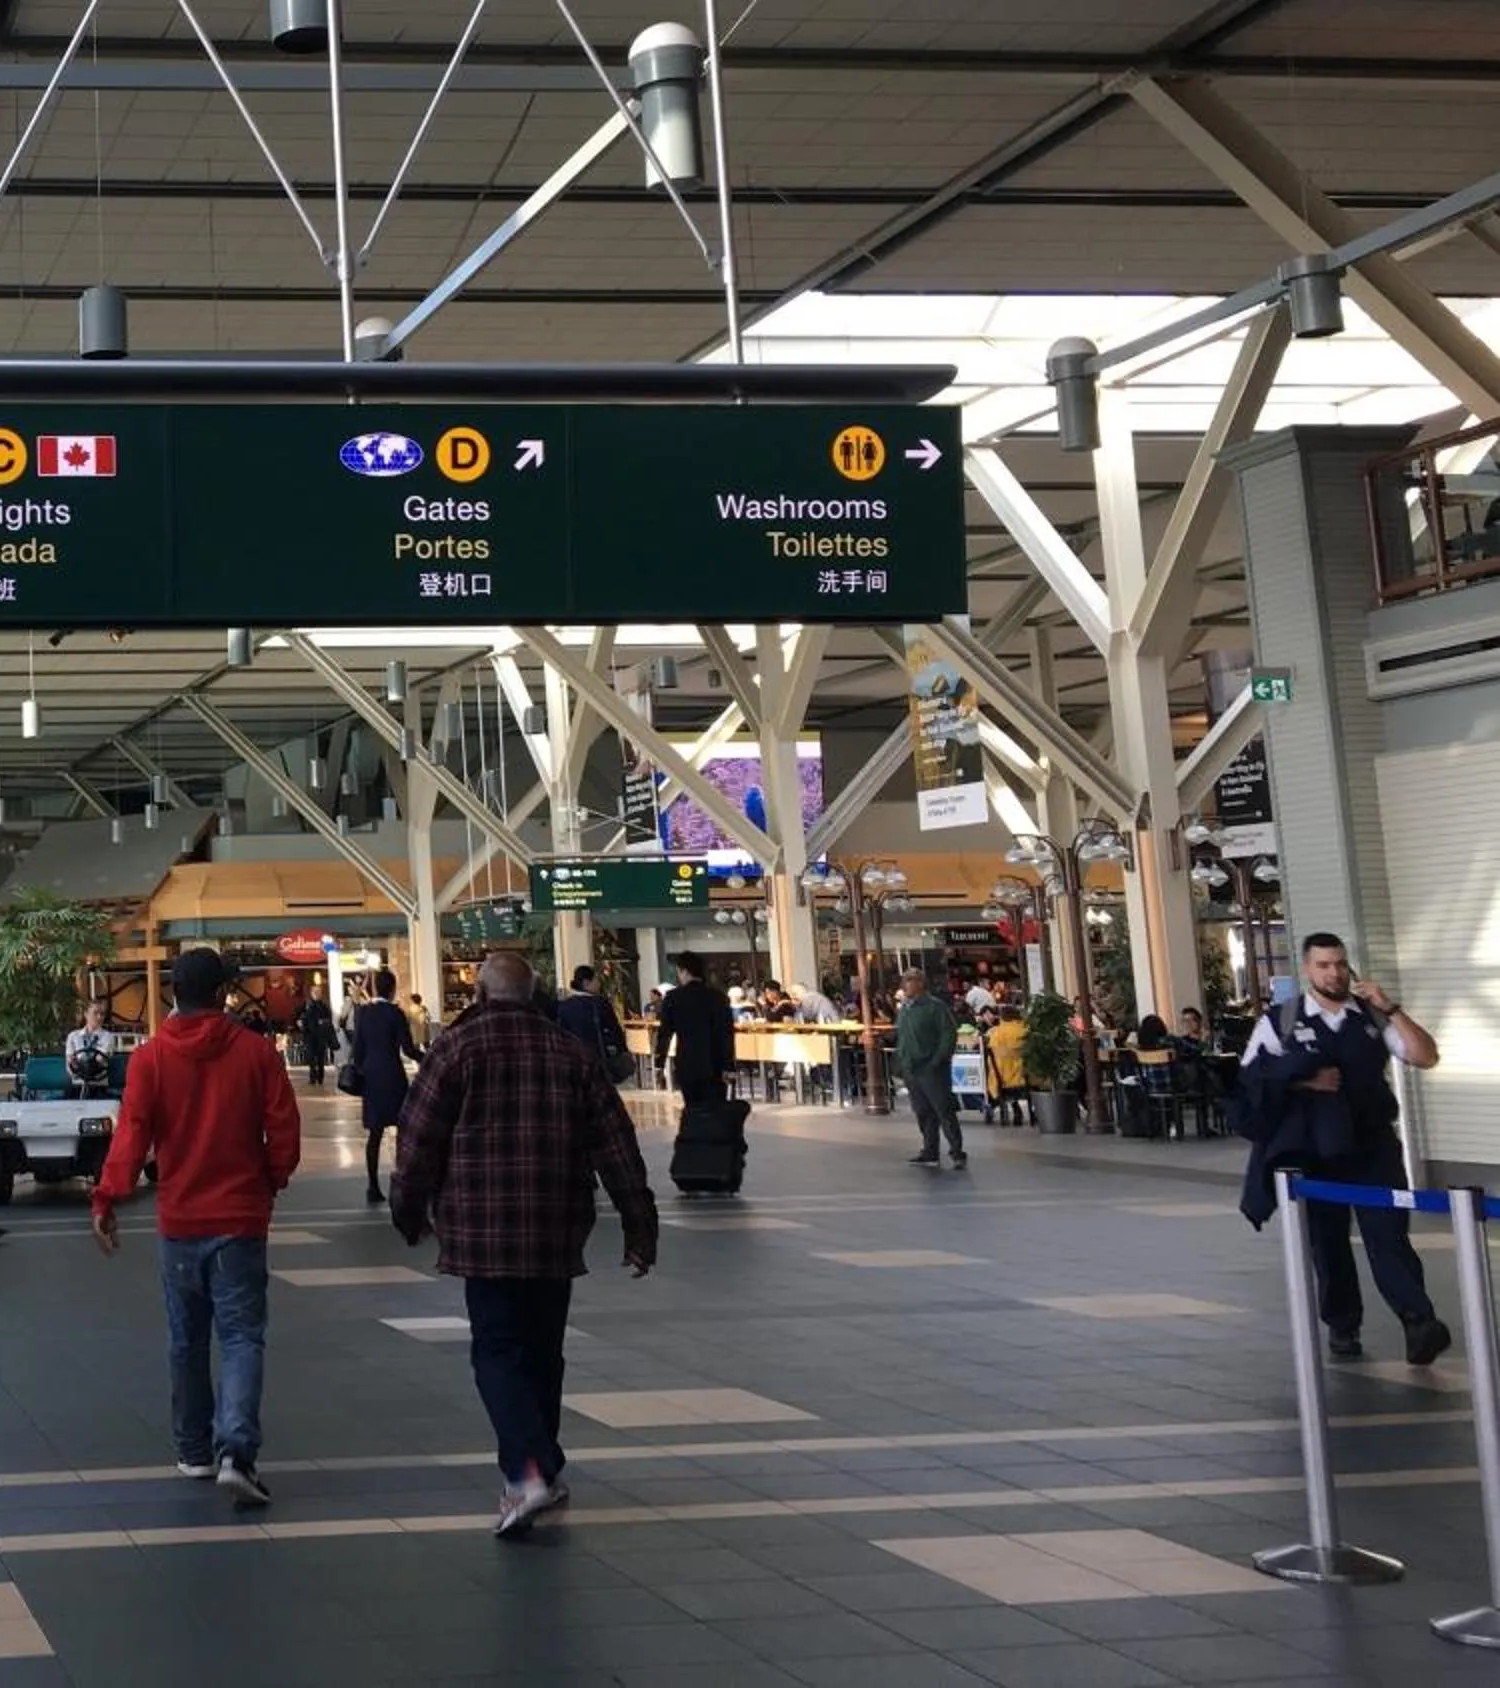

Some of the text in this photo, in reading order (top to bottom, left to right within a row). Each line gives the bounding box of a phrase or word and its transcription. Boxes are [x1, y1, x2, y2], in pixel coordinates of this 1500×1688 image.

[449, 439, 479, 470] D
[403, 495, 491, 522] Gates
[716, 493, 887, 520] Washrooms
[395, 533, 490, 559] Portes
[766, 531, 888, 557] Toilettes
[419, 571, 492, 597] 登机口
[817, 569, 887, 594] 洗手间
